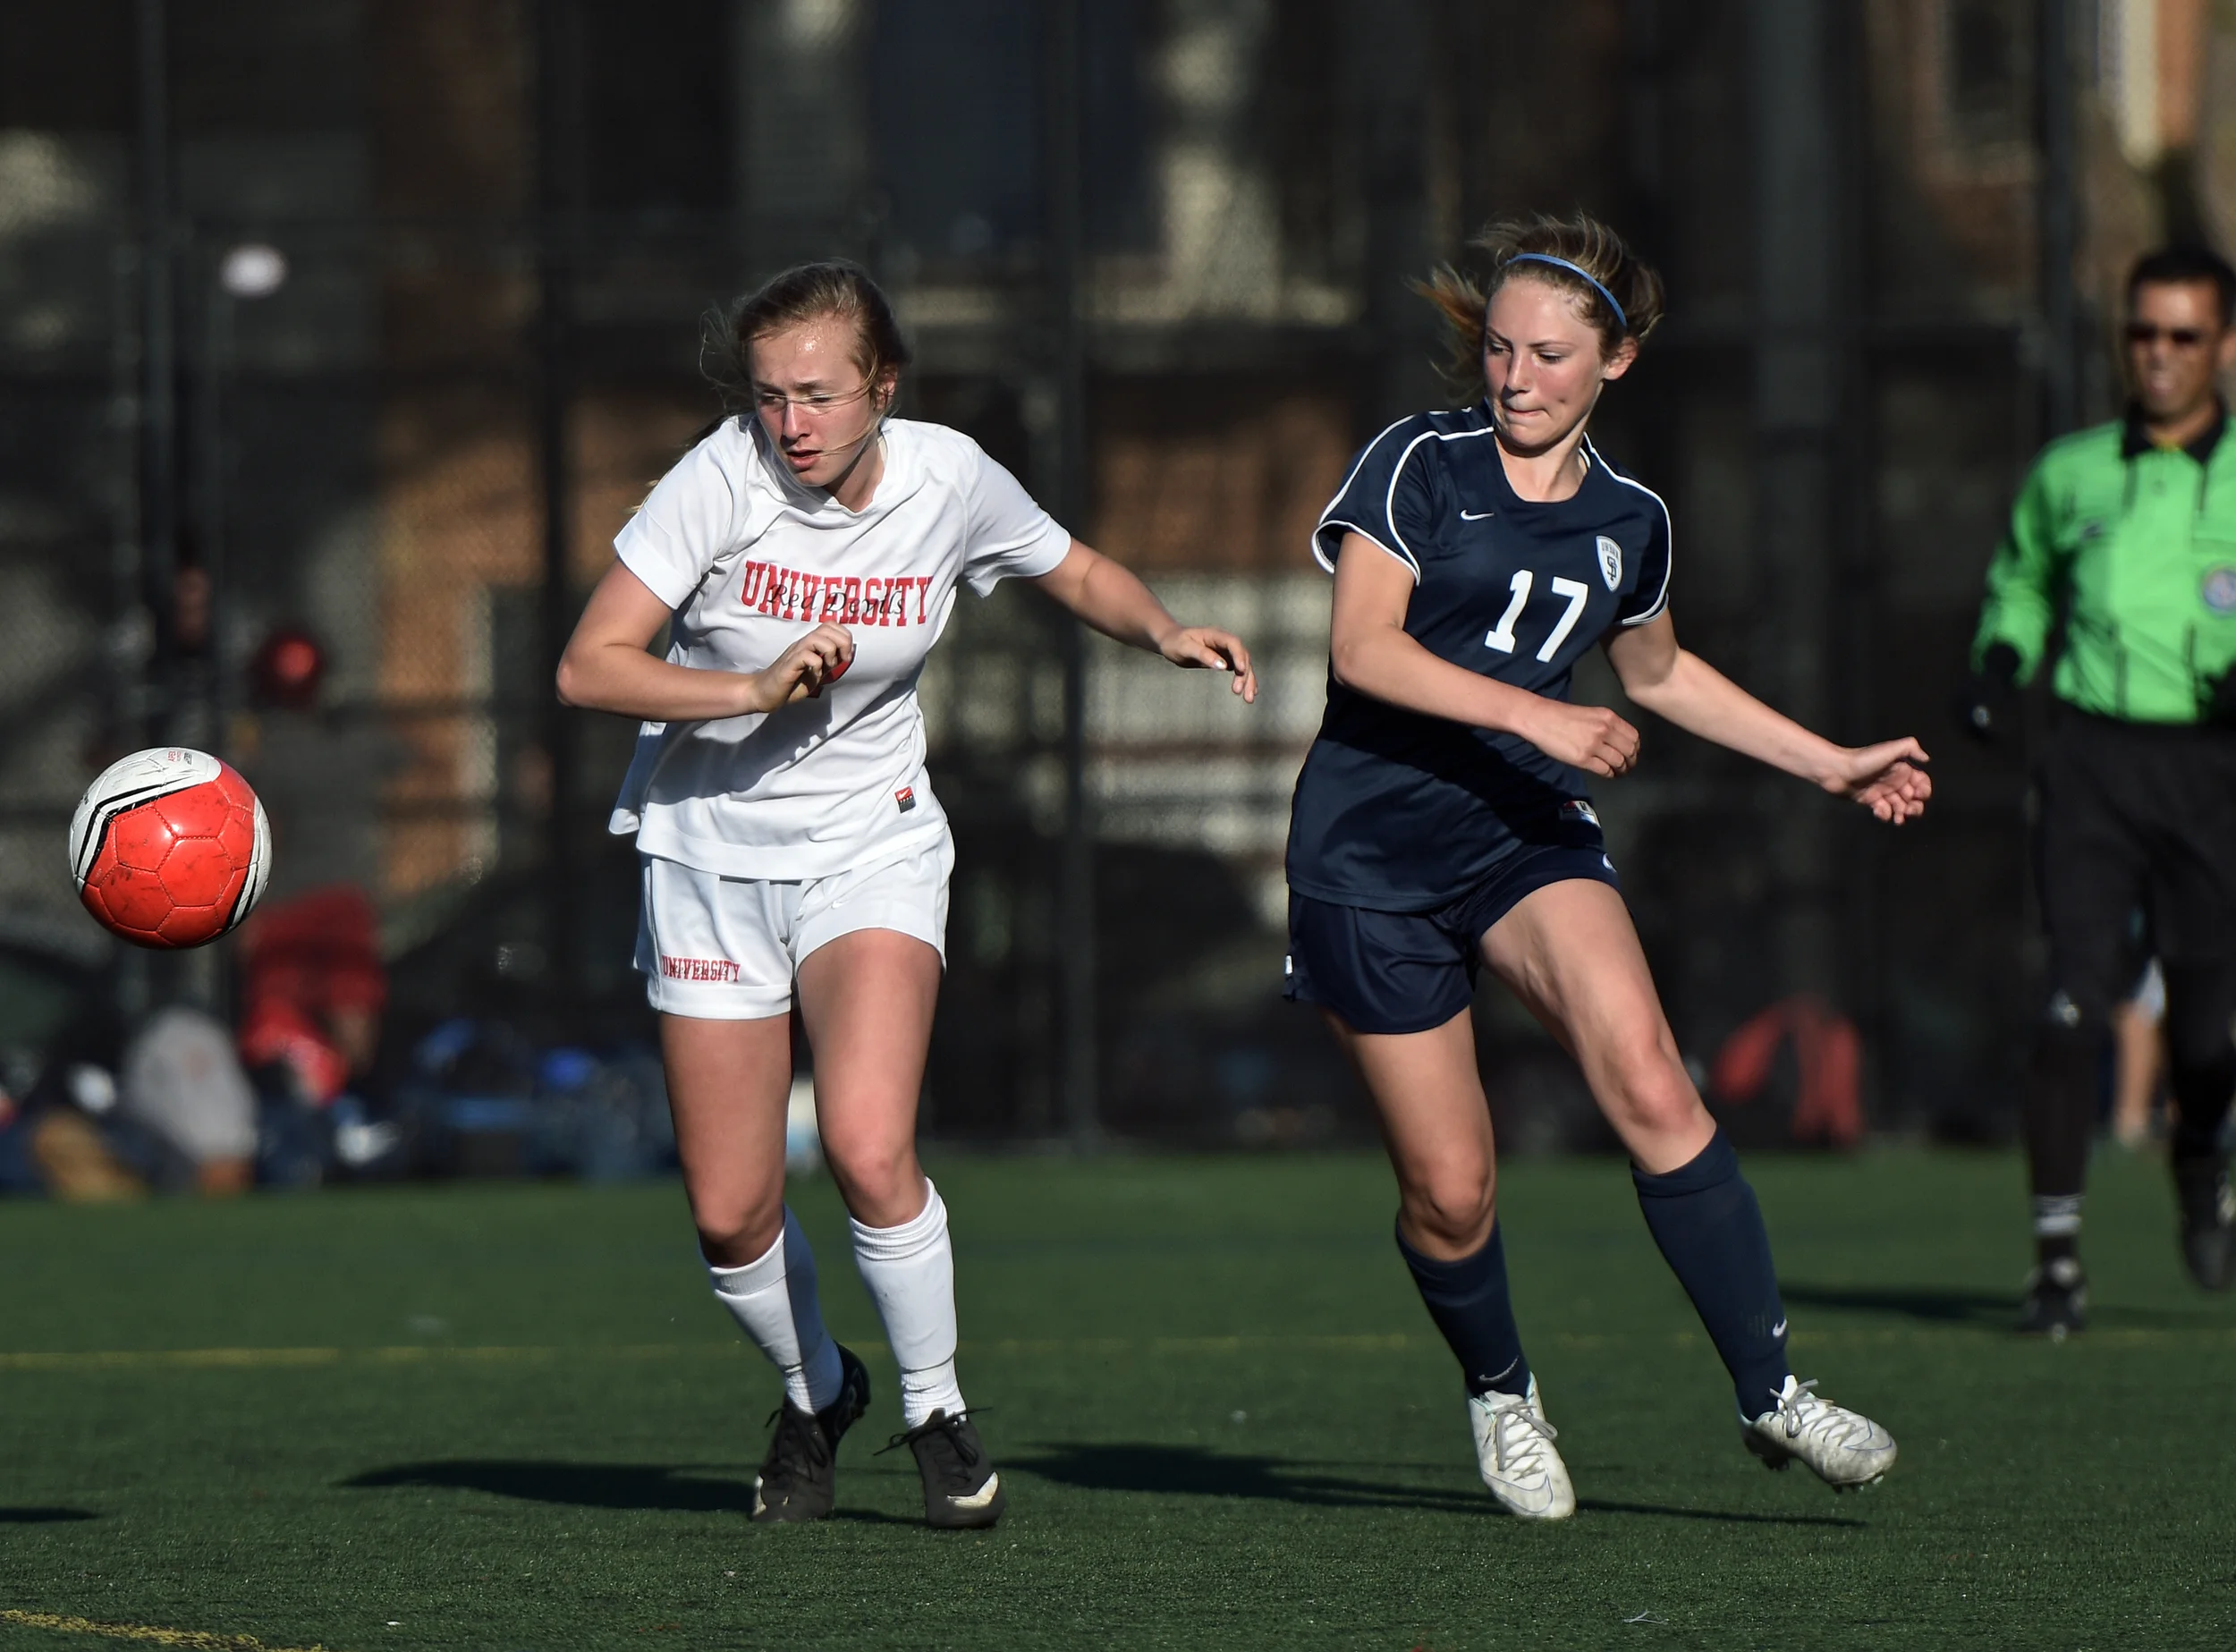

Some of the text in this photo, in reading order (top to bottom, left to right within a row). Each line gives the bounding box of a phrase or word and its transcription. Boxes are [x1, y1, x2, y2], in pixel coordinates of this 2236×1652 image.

[741, 560, 934, 626] UNIVERSITY
[768, 584, 905, 614] Red Devils
[1485, 570, 1588, 663] 17
[662, 954, 741, 982] UNIVERSITY
